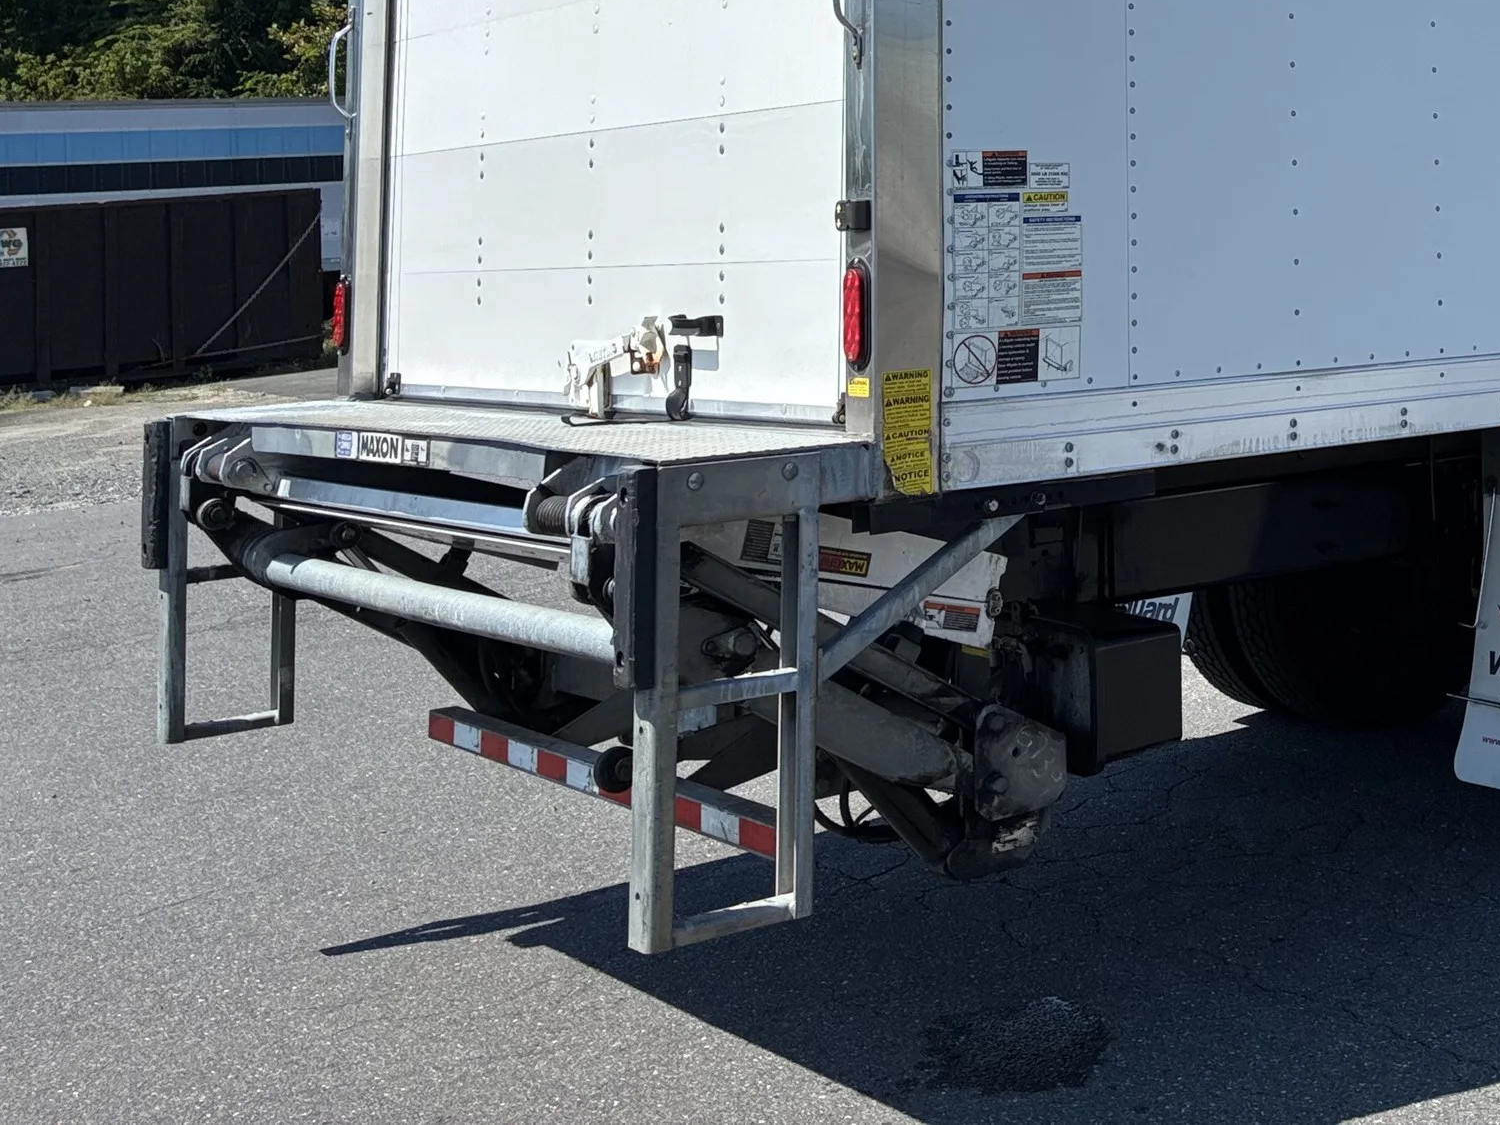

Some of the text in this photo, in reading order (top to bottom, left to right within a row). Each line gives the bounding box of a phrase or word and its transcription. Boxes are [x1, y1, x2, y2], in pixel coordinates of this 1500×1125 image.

[1033, 193, 1065, 201] CAUTION
[892, 370, 928, 381] WARNING
[892, 395, 930, 406] WARNING
[892, 428, 929, 439] CAUTION
[361, 435, 399, 459] MAXON
[896, 450, 925, 461] NOTICE
[894, 469, 930, 482] NOTICE
